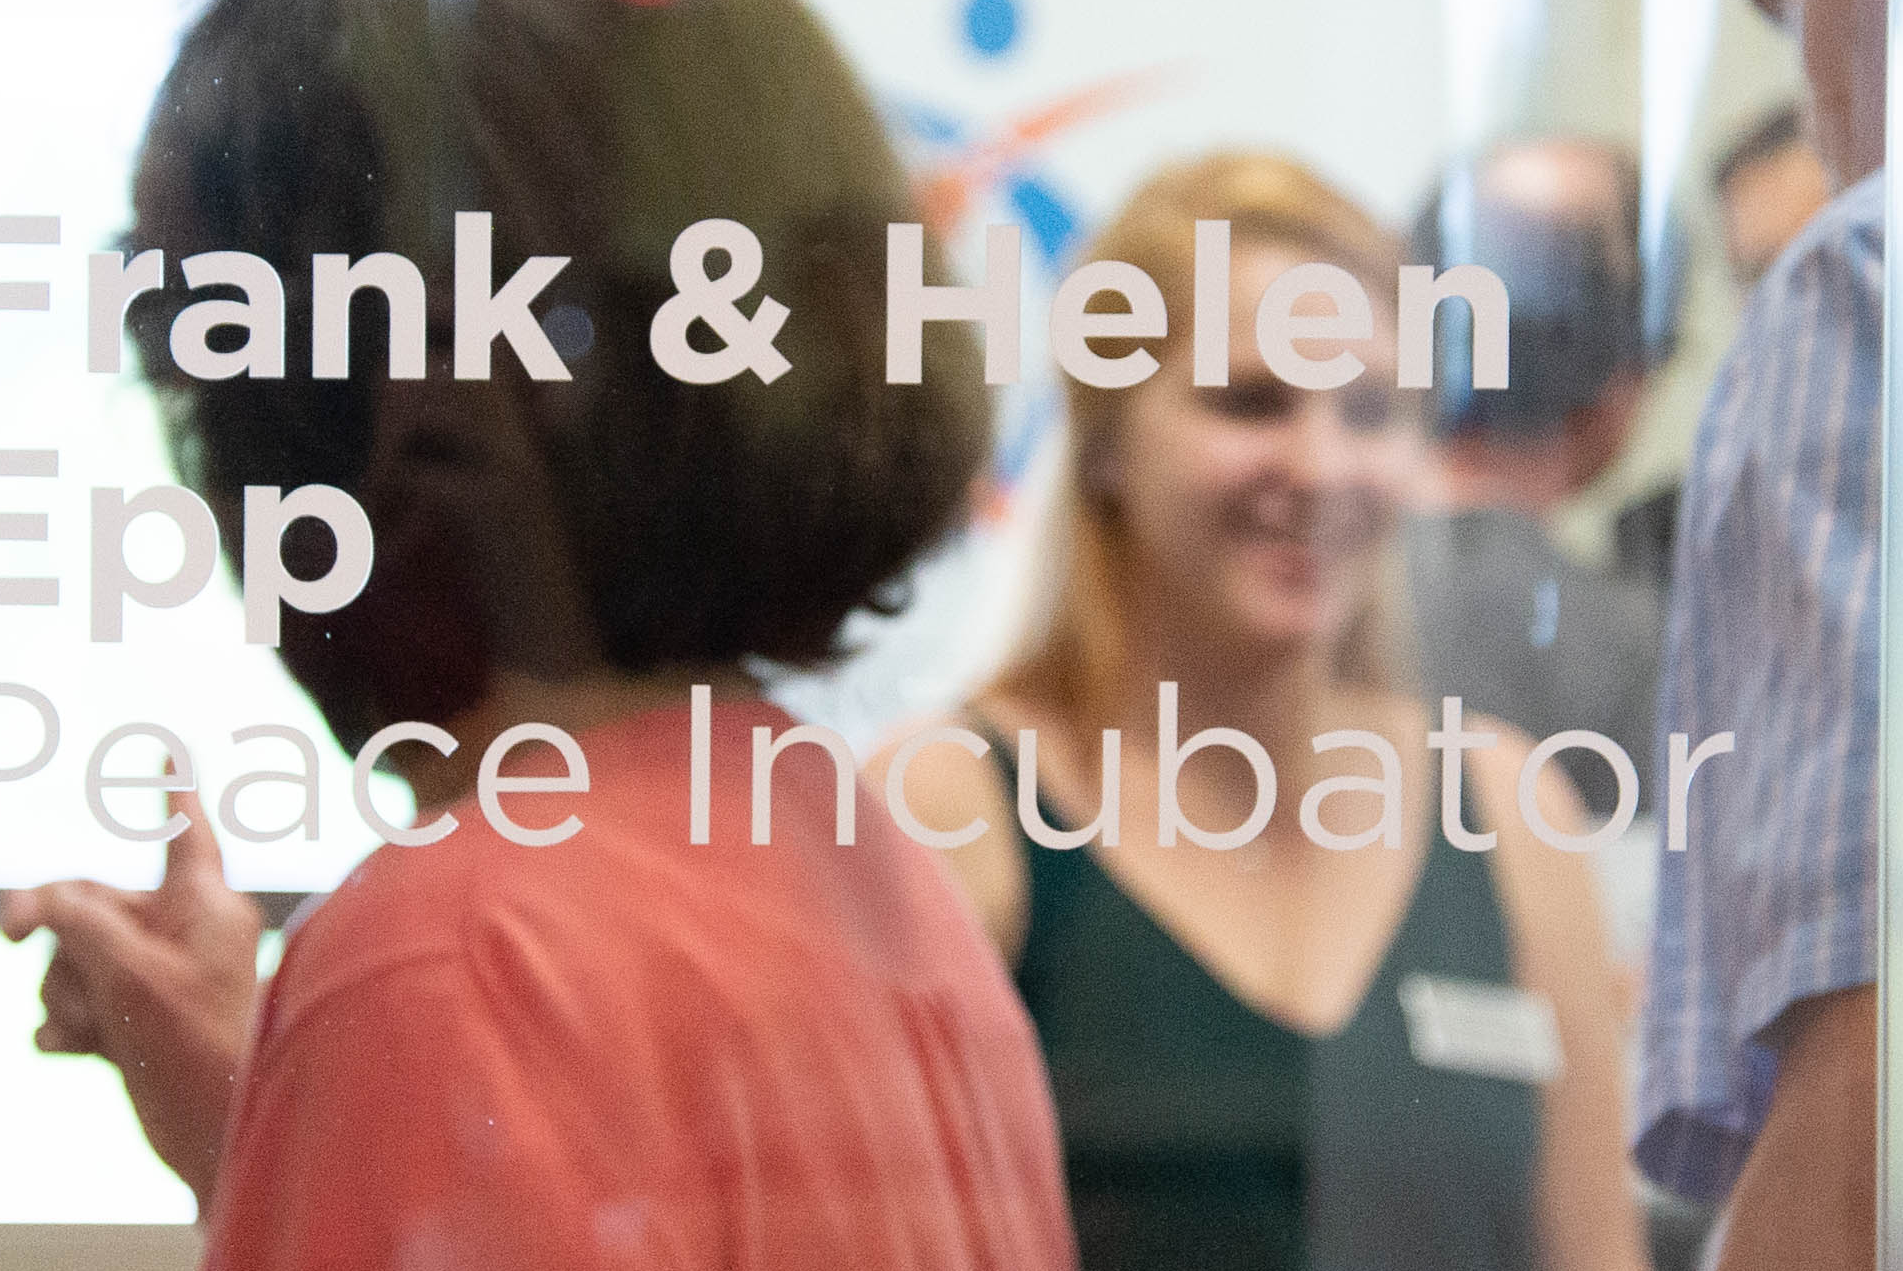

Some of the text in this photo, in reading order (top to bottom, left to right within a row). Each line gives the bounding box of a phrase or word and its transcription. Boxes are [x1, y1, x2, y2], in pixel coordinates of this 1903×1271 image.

[647, 217, 794, 388] &
[883, 218, 1511, 391] Helen
[687, 679, 1736, 853] Incubator
